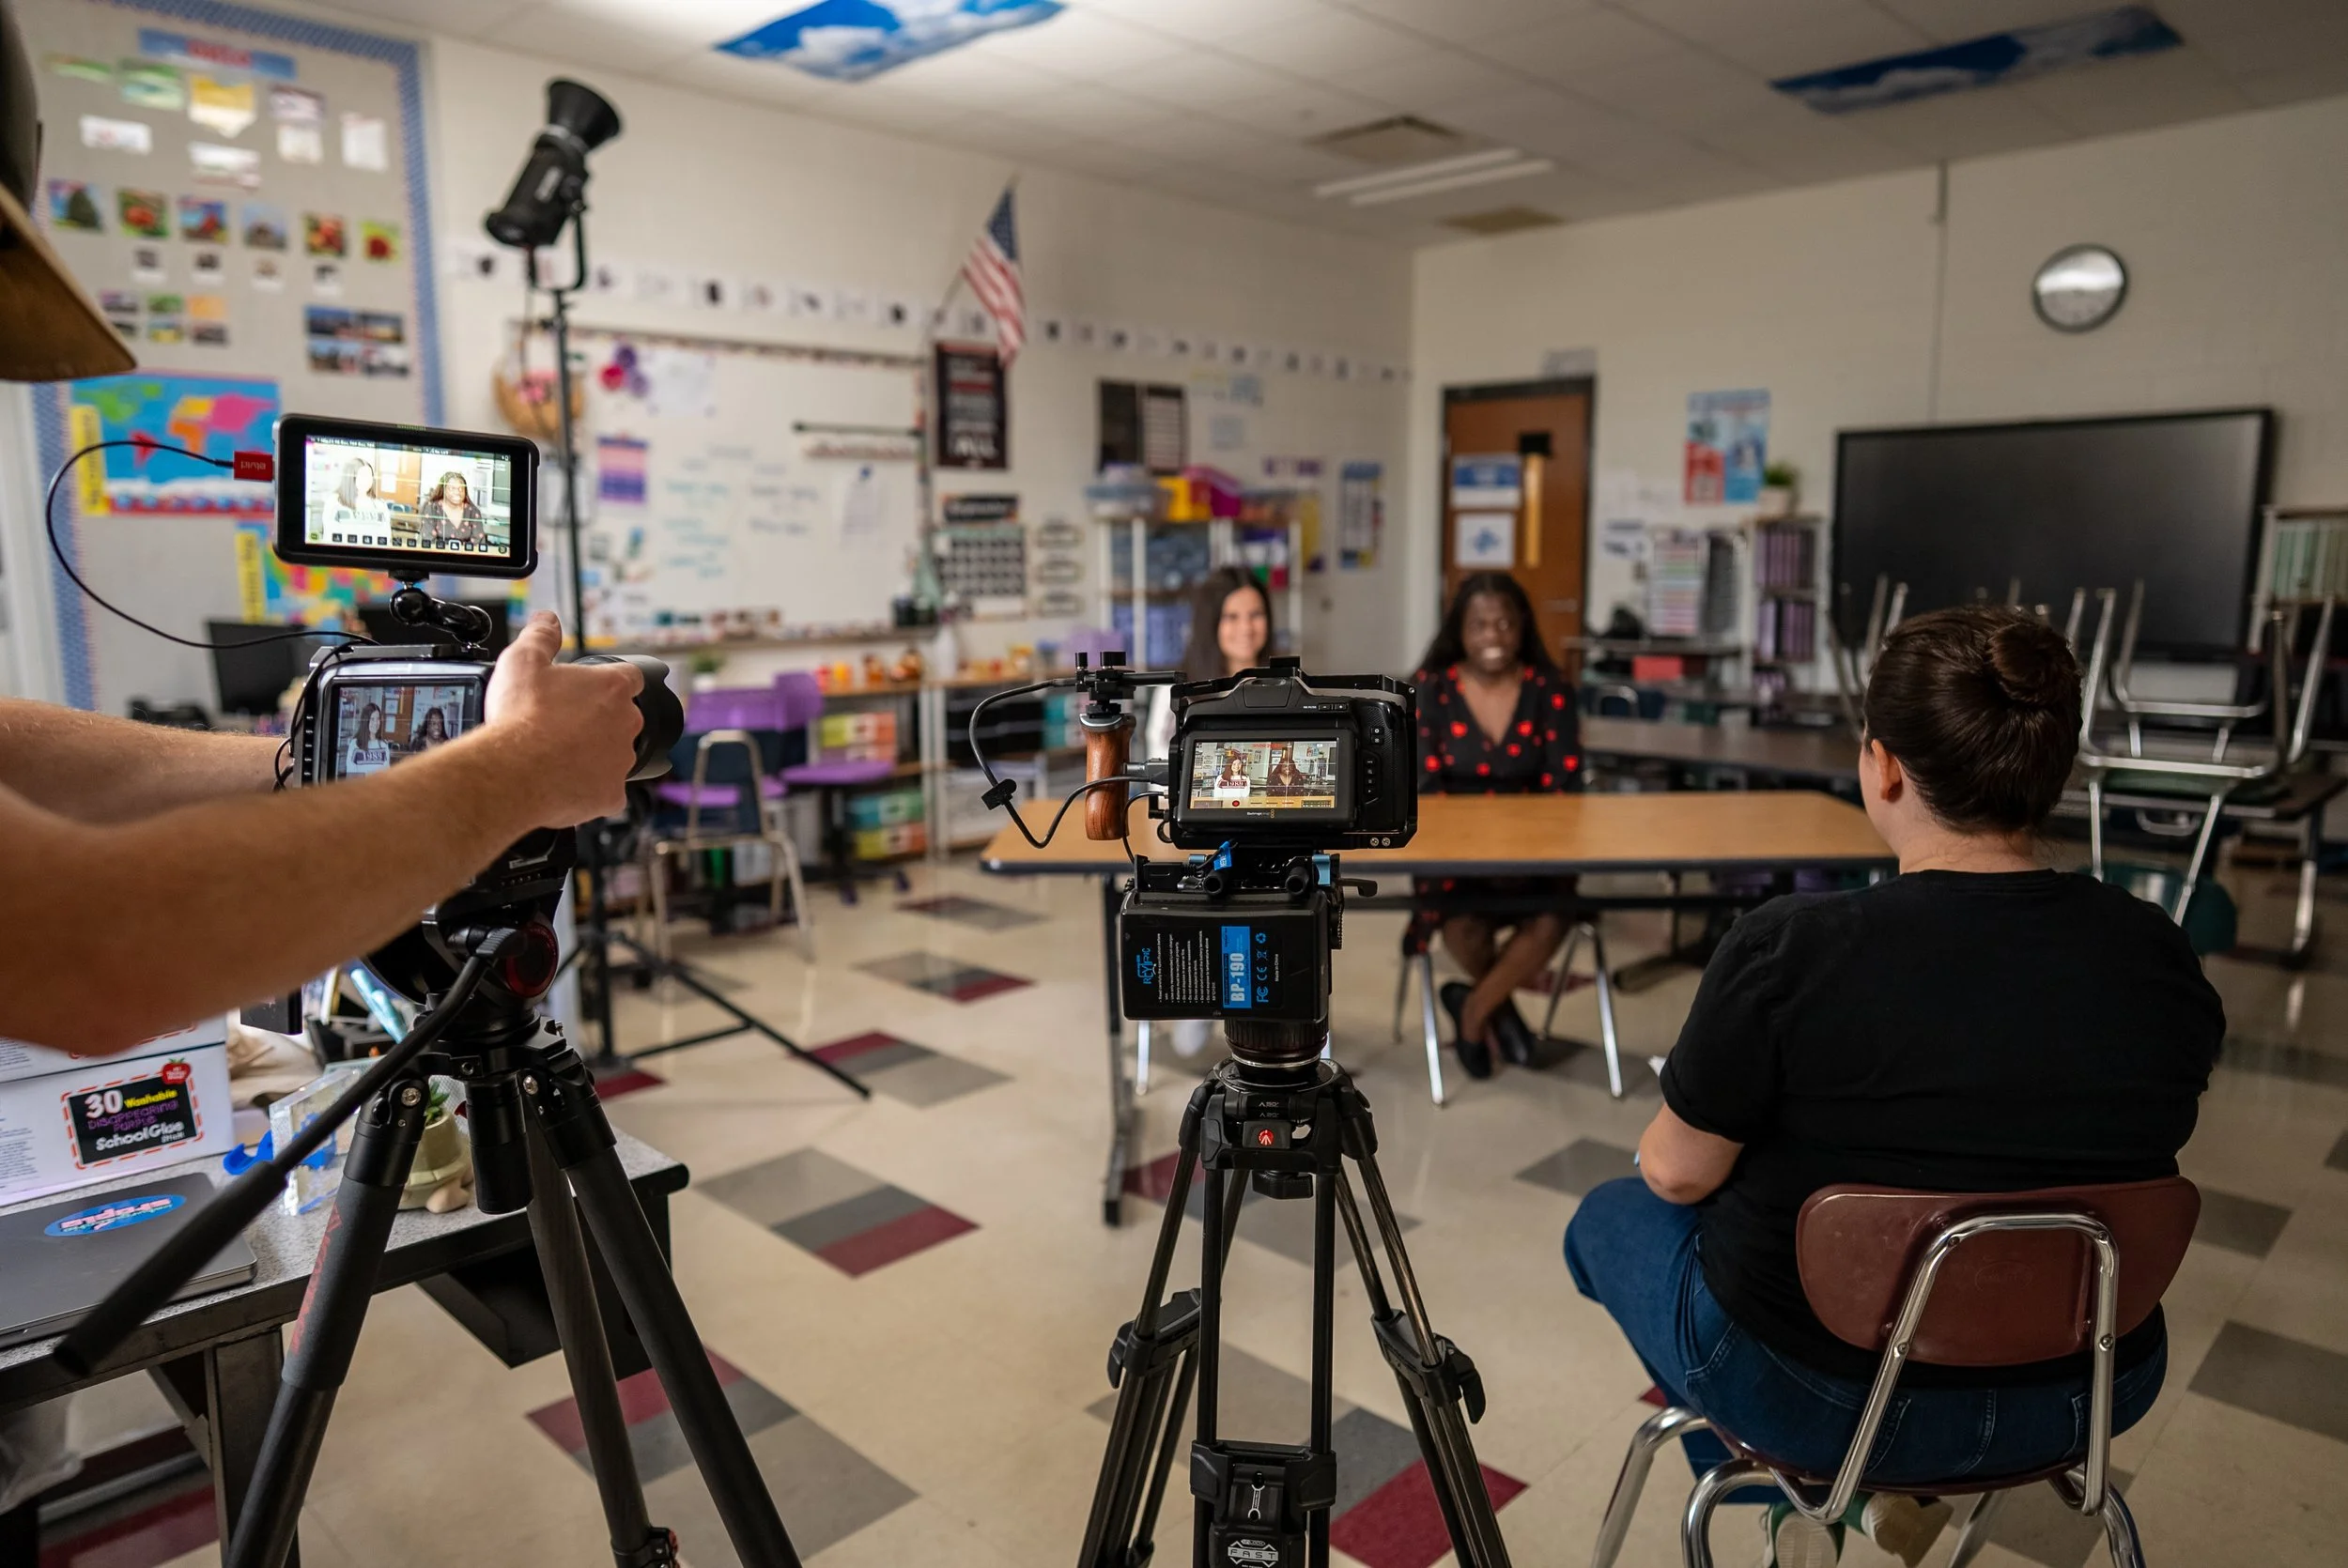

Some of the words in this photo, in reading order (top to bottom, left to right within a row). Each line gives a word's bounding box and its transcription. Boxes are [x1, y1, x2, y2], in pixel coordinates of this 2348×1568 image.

[1229, 953, 1245, 1001] BP-190
[85, 1089, 123, 1119] 30
[124, 1089, 178, 1108] Washable
[96, 1127, 149, 1151] School
[1230, 1549, 1275, 1560] FAST
